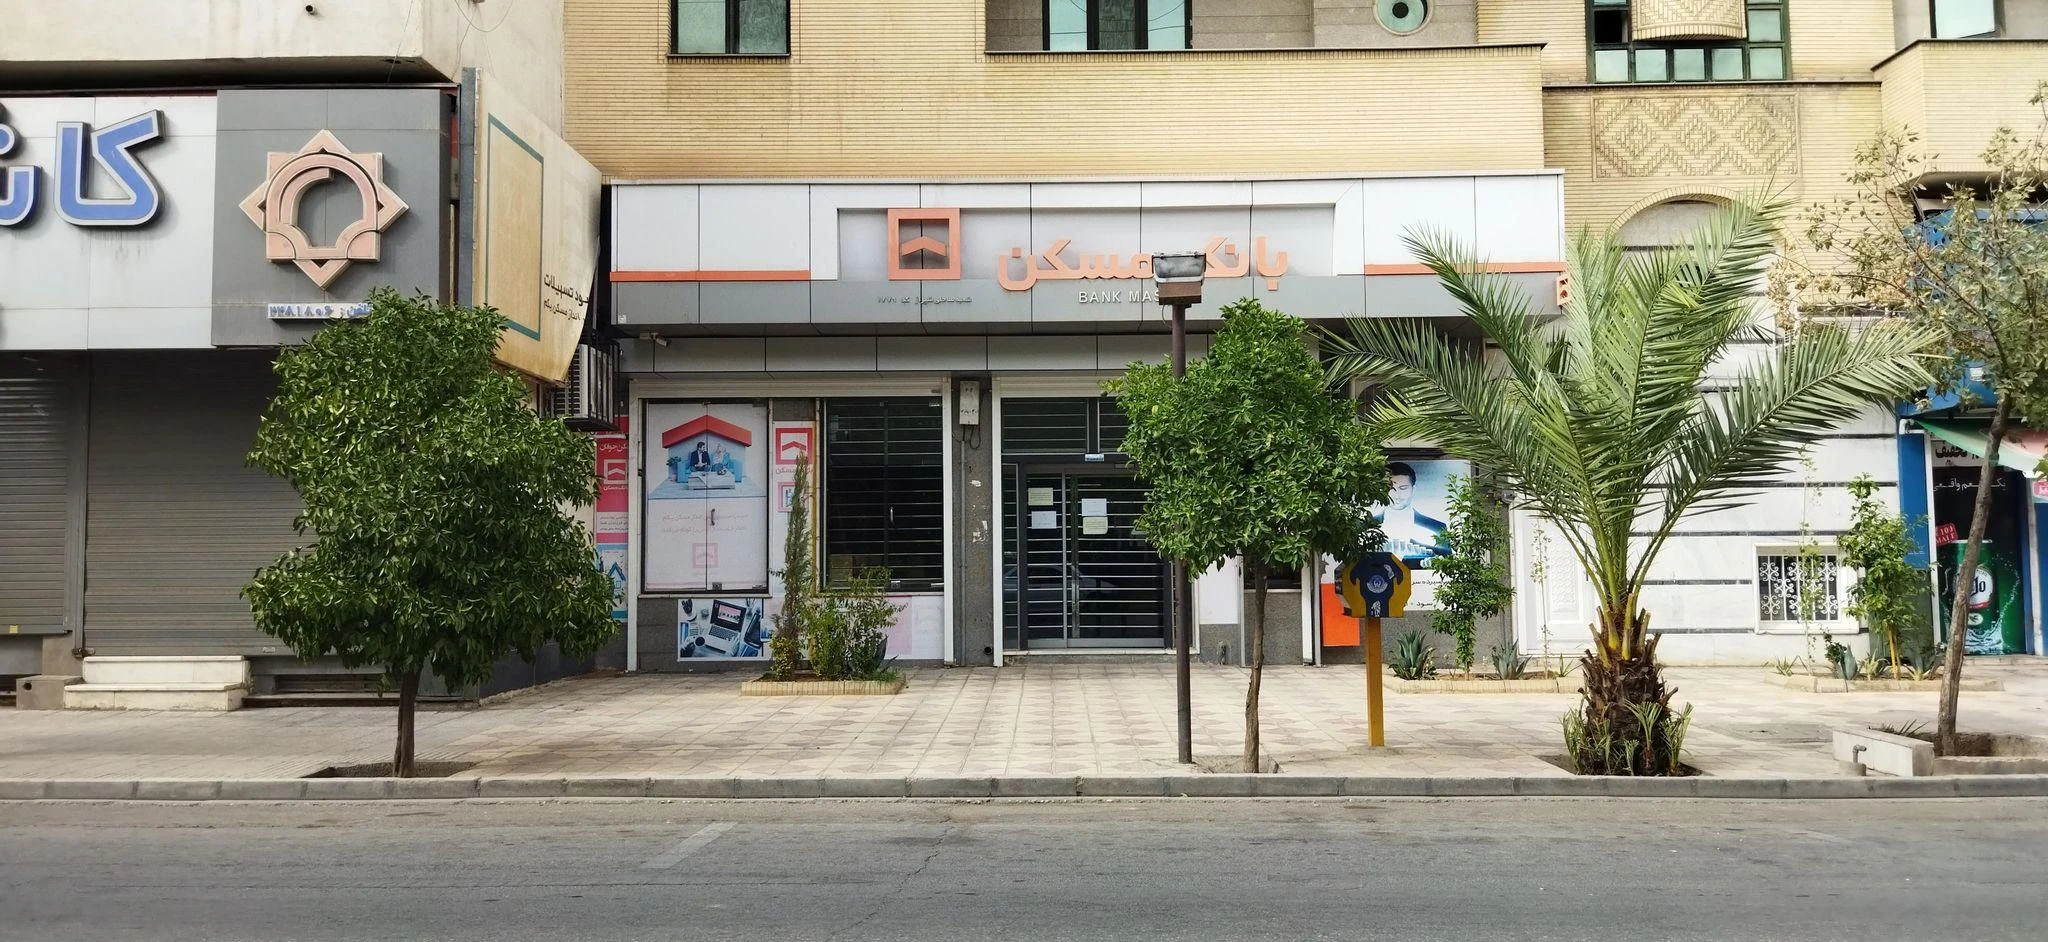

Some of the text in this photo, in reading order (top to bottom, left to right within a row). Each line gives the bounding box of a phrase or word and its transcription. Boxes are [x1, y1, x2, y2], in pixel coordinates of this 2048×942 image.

[998, 239, 1155, 291] مسکن
[1079, 291, 1160, 304] BANK MAS
